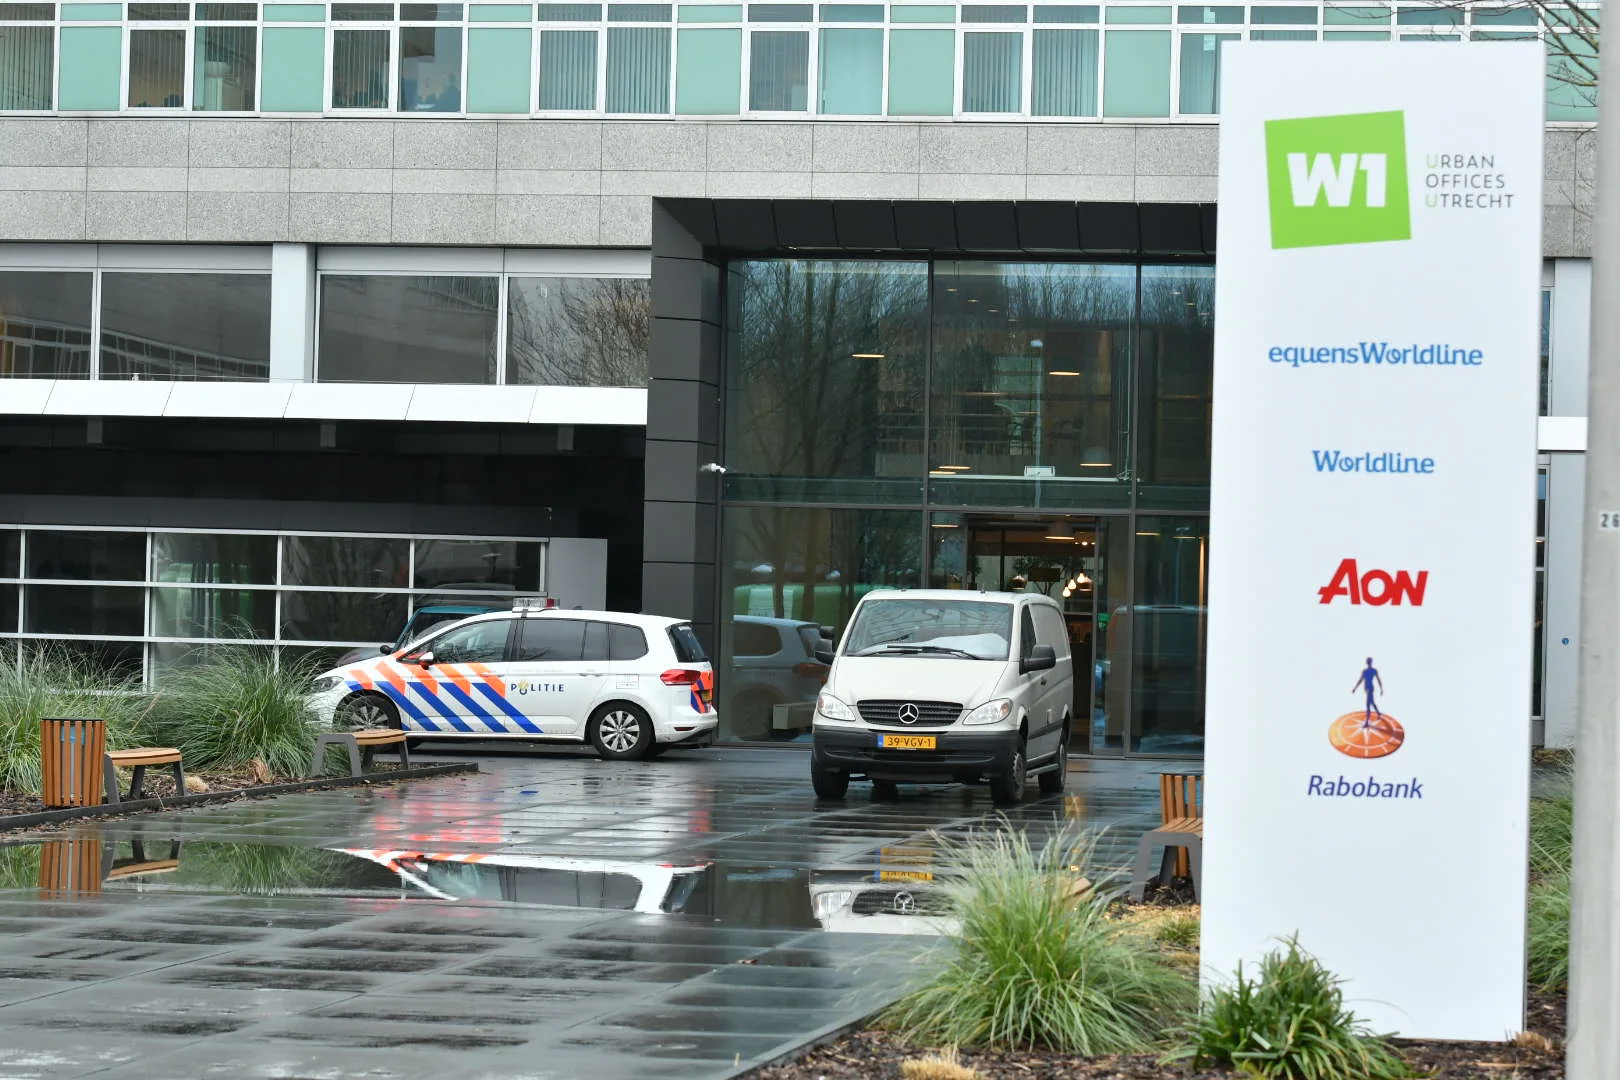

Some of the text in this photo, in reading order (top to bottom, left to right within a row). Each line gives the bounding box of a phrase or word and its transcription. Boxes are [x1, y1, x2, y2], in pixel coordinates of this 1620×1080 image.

[1425, 153, 1495, 169] URBAN
[1286, 152, 1387, 208] W1
[1425, 173, 1506, 189] OFFICES
[1425, 193, 1515, 209] UTRECHT
[1268, 342, 1483, 367] equensWorldline
[1312, 450, 1435, 474] Worldline
[510, 680, 565, 695] POLITIE
[887, 736, 931, 747] 39-VGV-1
[1307, 775, 1423, 800] Rabobank
